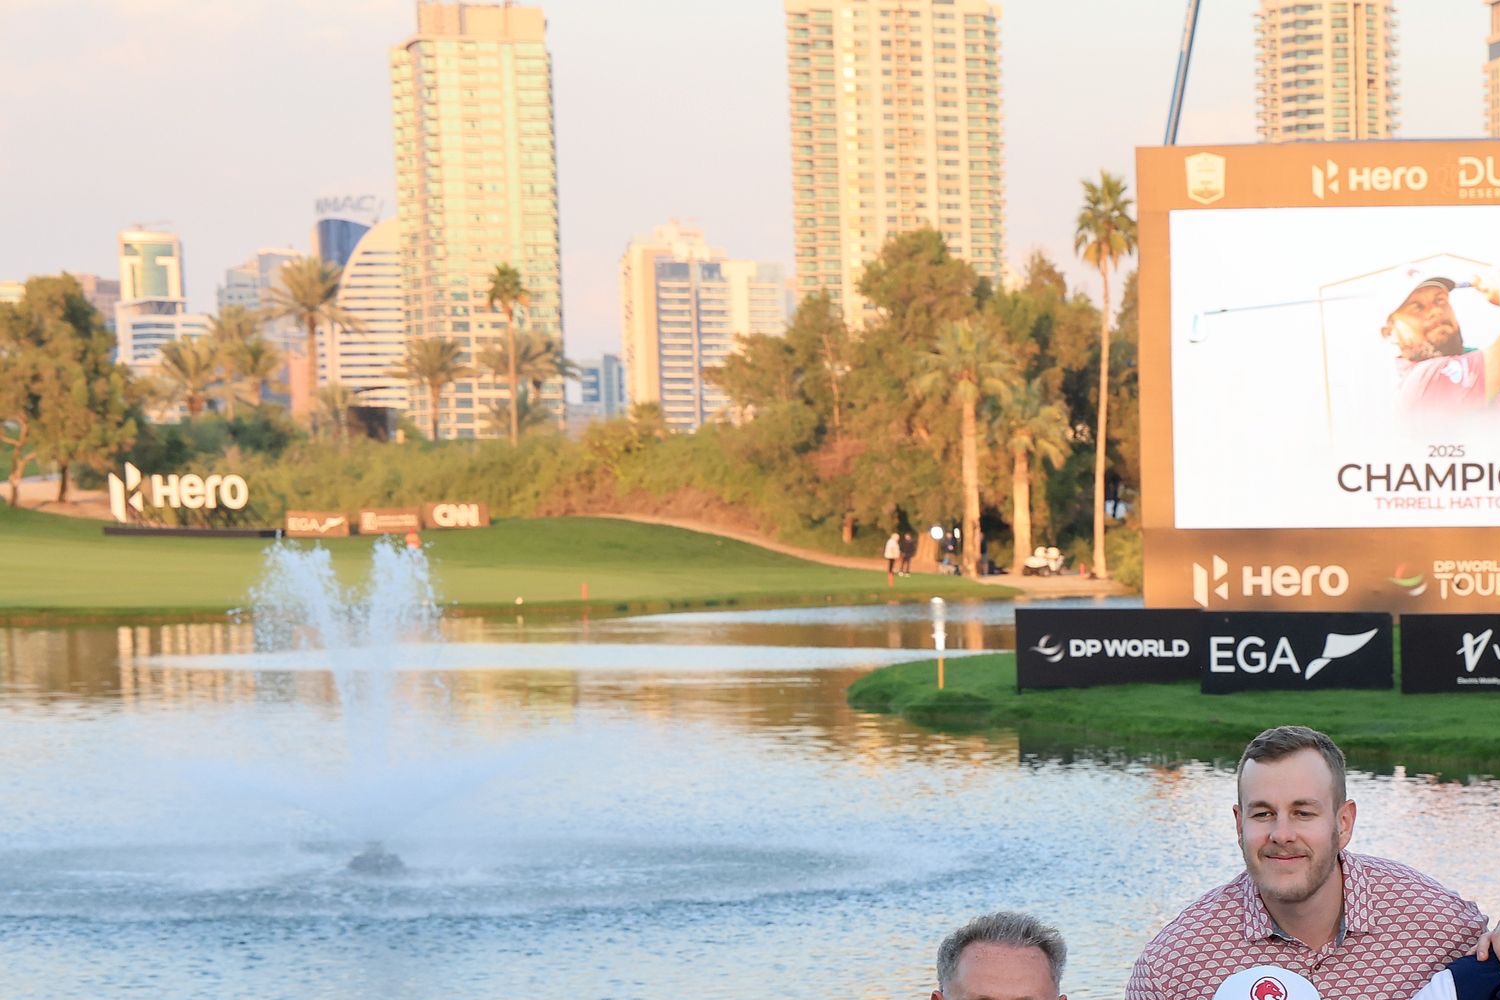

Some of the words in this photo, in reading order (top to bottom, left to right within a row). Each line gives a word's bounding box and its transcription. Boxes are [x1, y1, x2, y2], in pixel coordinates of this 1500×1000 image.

[1348, 165, 1429, 192] Hero
[1428, 444, 1466, 458] 2025
[151, 473, 249, 509] Hero
[1375, 496, 1445, 510] TYRRELL
[432, 503, 480, 527] CNN
[1433, 560, 1456, 573] DP
[1242, 564, 1350, 597] Hero
[1069, 638, 1101, 658] DP
[1102, 638, 1191, 658] WORLD
[1209, 635, 1302, 674] EGA
